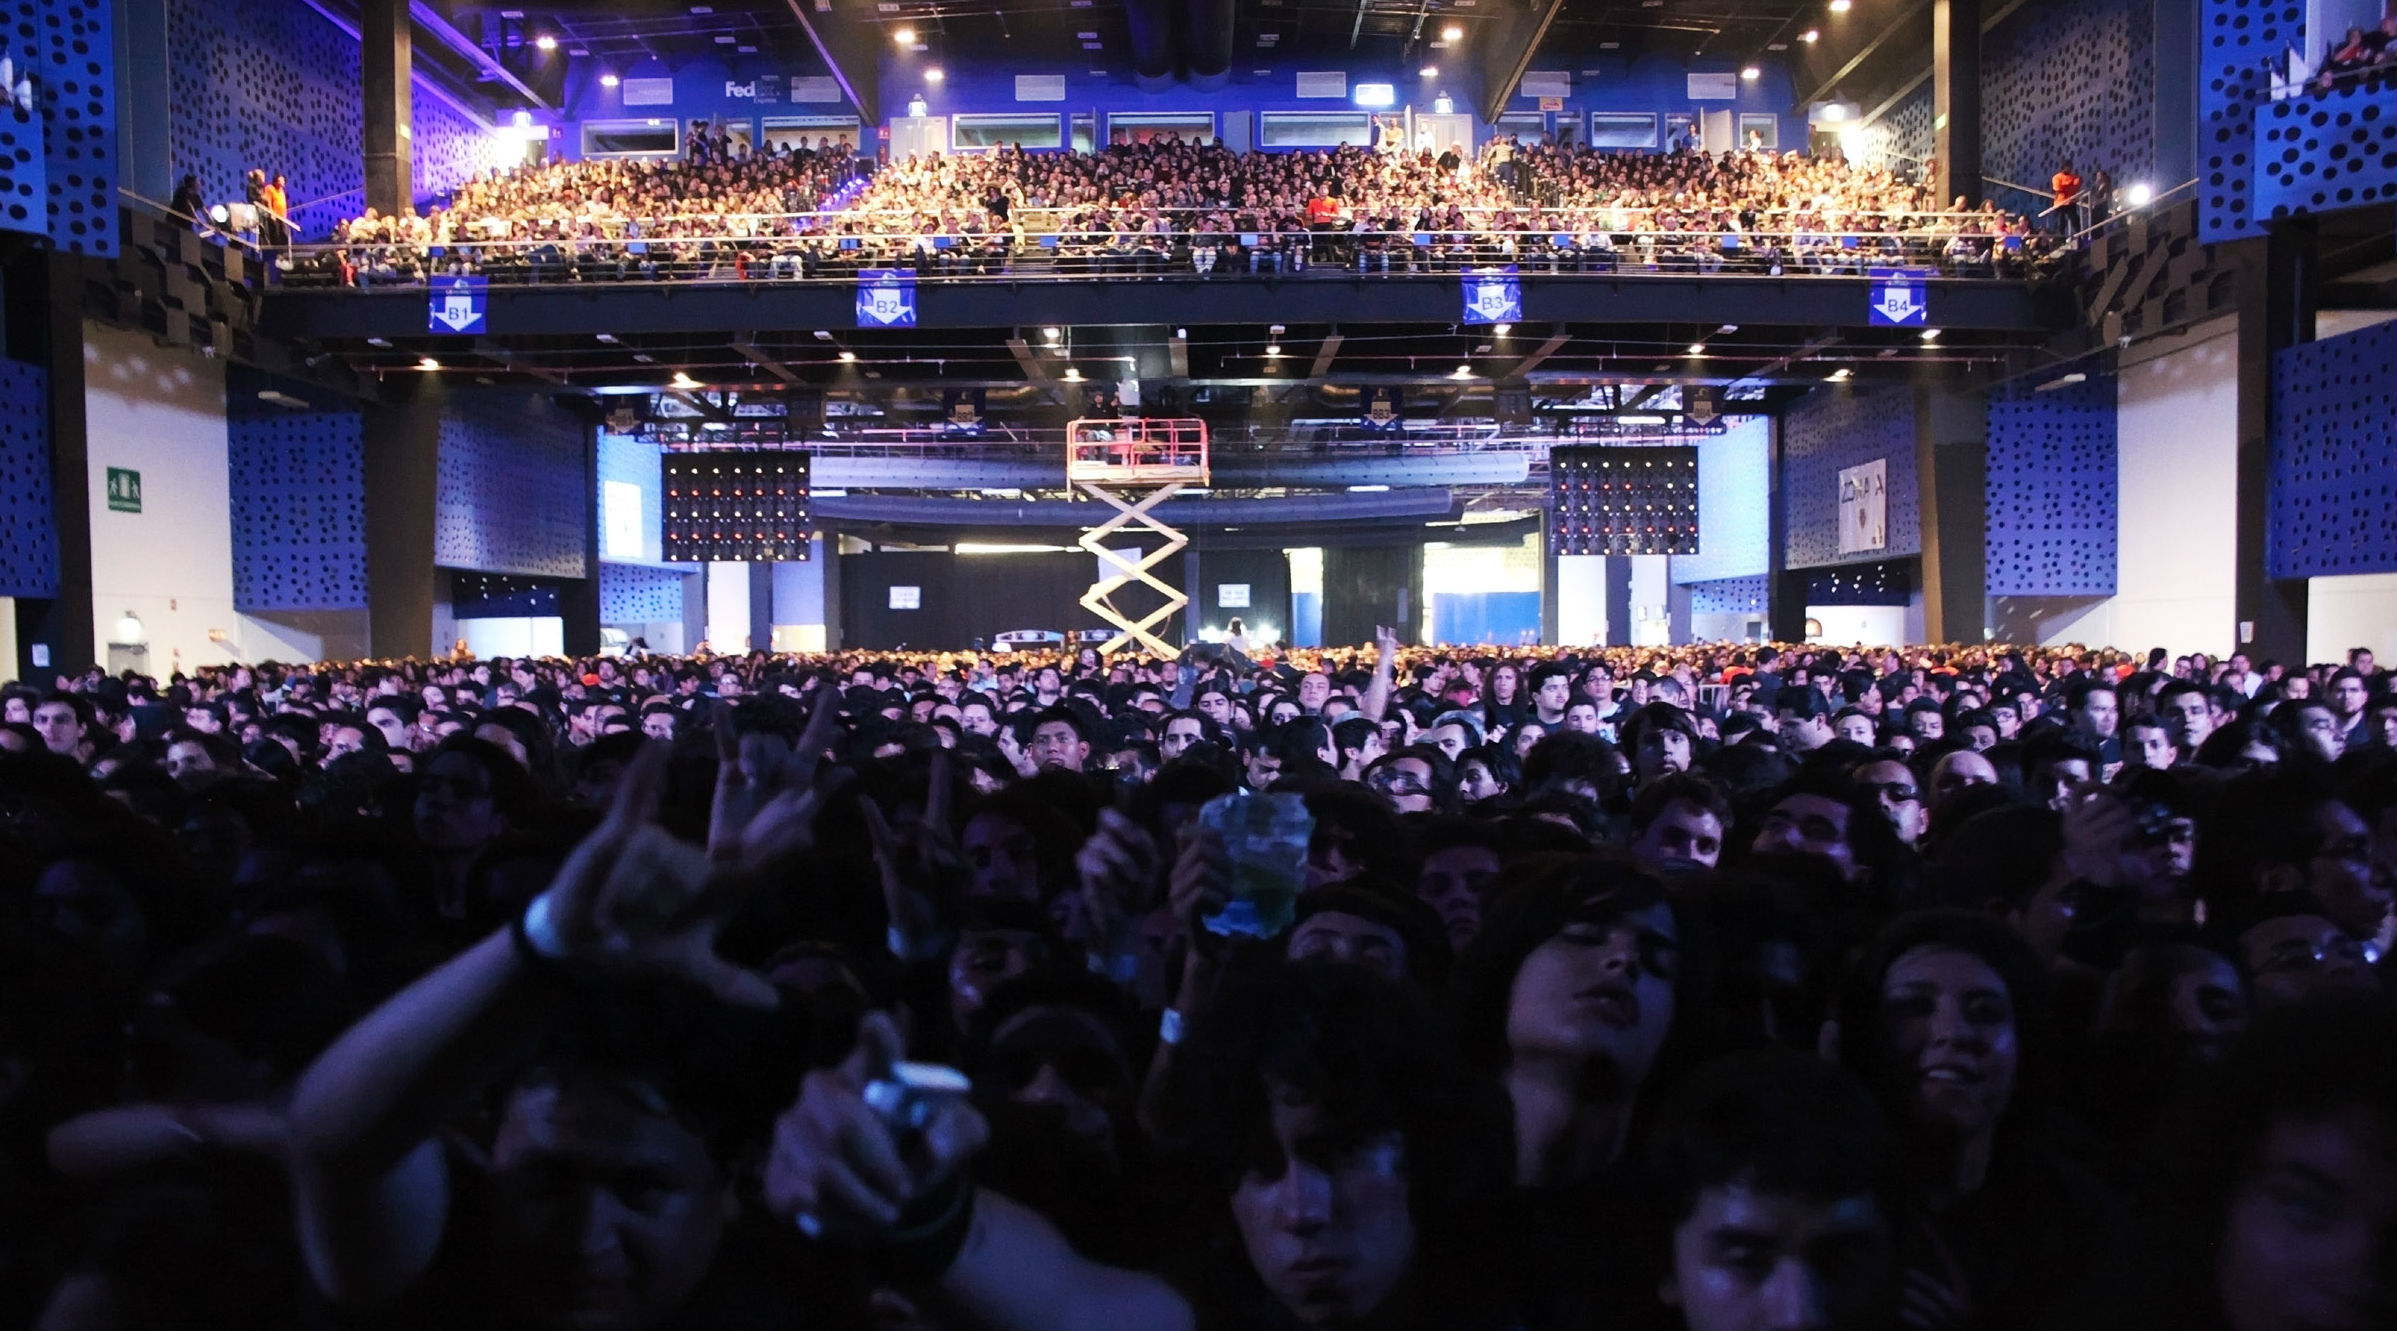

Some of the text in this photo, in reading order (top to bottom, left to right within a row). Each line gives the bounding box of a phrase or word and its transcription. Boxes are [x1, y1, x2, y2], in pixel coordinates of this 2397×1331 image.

[876, 300, 898, 313] B2
[1482, 296, 1504, 310] B3
[1888, 299, 1908, 312] B4
[449, 307, 467, 320] B1
